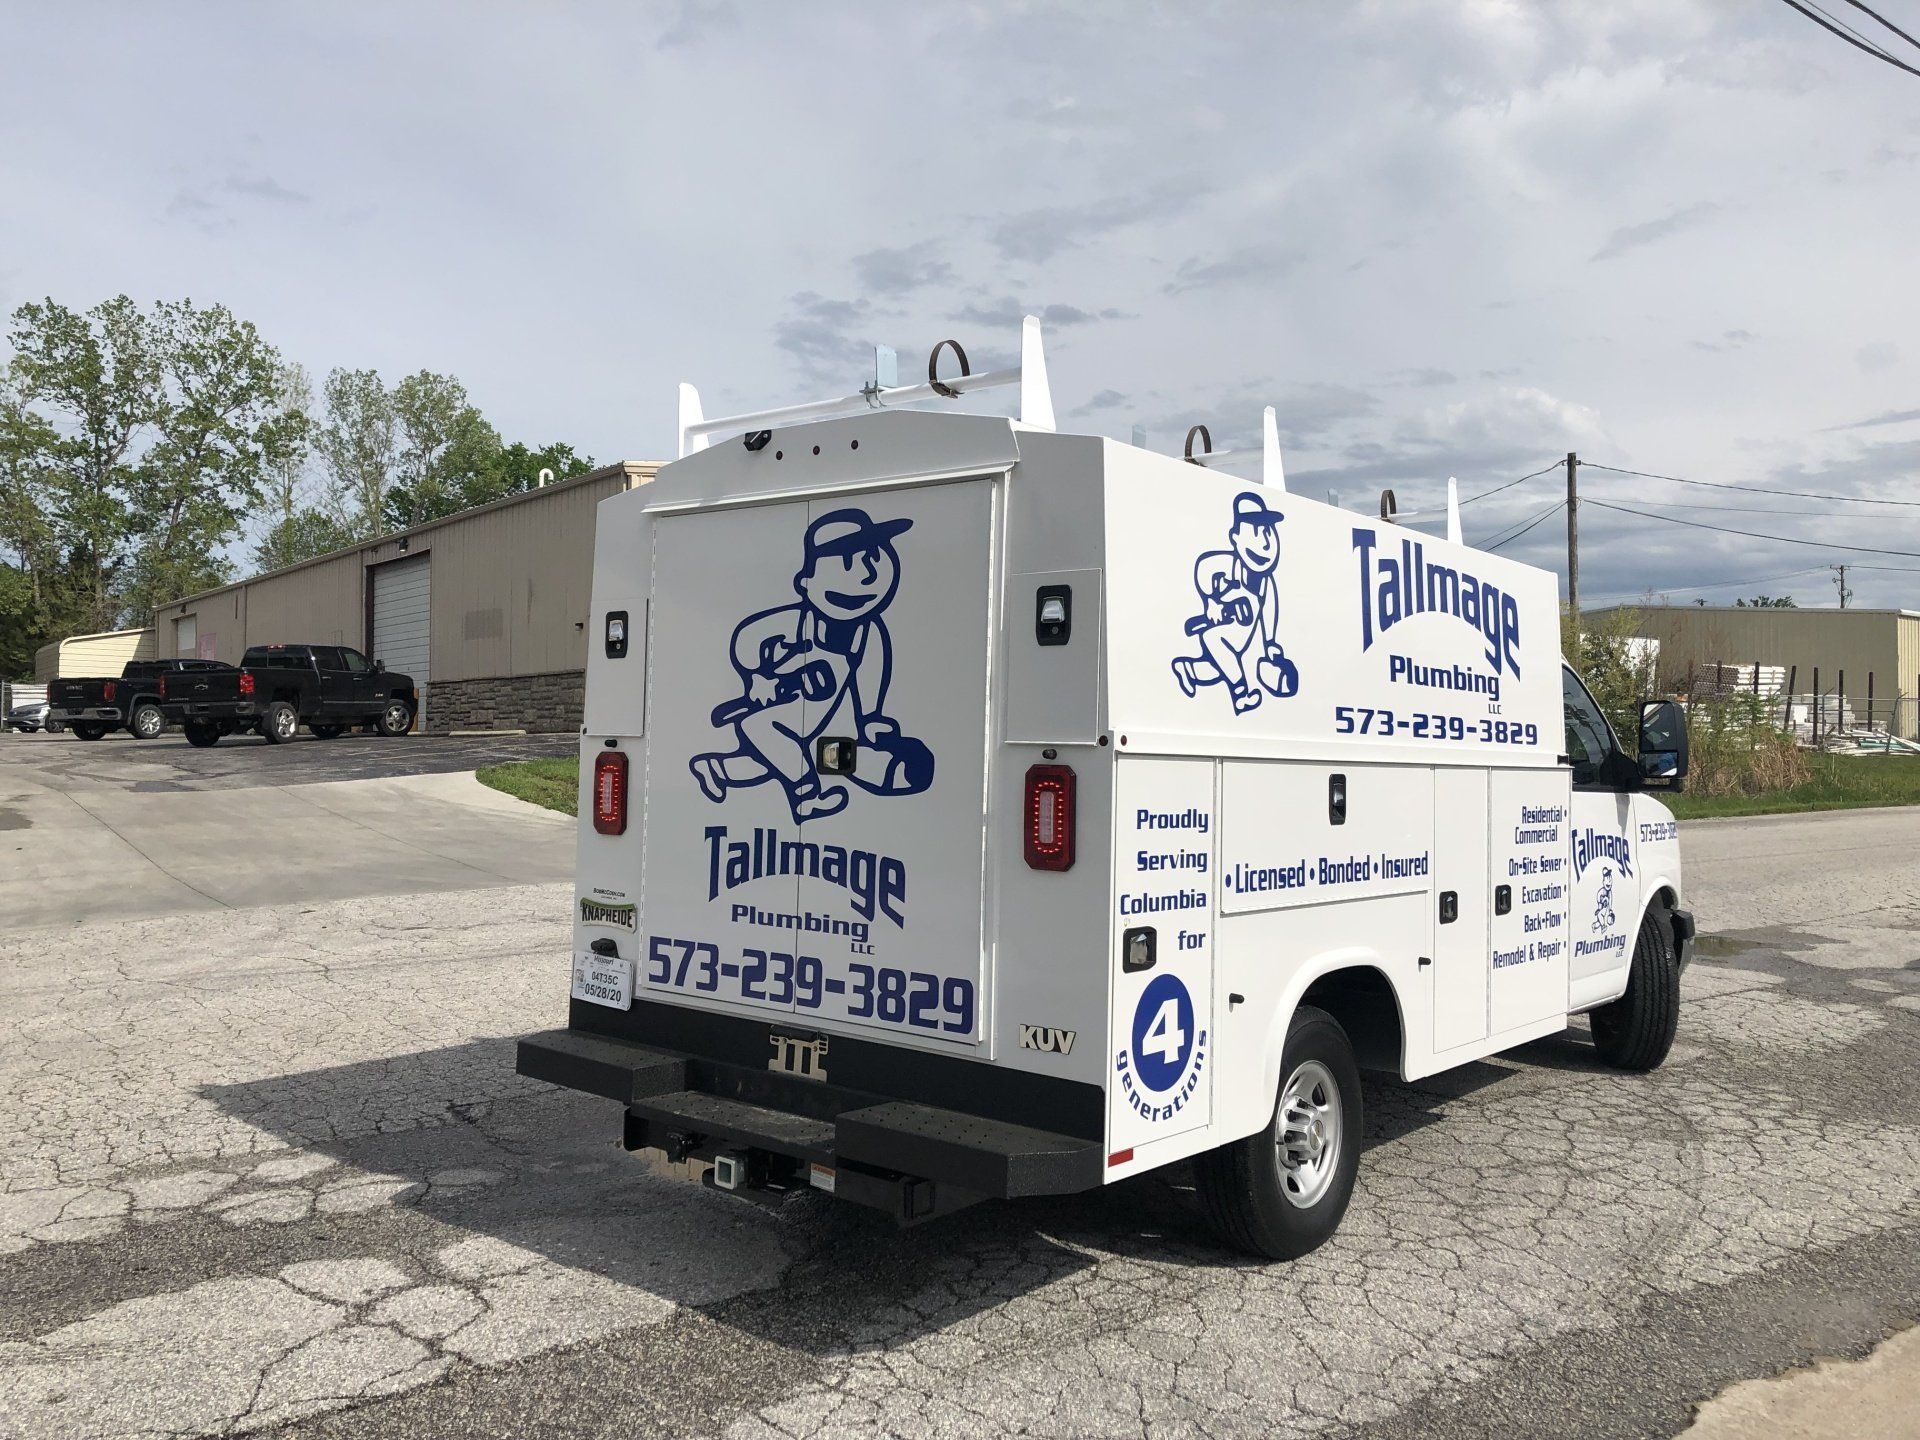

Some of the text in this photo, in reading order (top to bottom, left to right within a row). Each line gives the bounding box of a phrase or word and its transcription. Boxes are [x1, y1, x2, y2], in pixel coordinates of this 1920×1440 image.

[1352, 527, 1520, 682] Tallmage
[1389, 654, 1500, 701] Plumbing
[1488, 703, 1502, 715] LLC
[1335, 706, 1538, 746] 573-239-3829
[1136, 808, 1209, 833] Proudly
[1521, 805, 1563, 824] Residential
[1515, 827, 1558, 844] Commercial
[1136, 849, 1208, 872] Serving
[1508, 854, 1562, 876] On-Site Sewer
[1571, 827, 1634, 885] Tallmage
[704, 825, 906, 930] Tallmage
[1235, 851, 1429, 894] Licensed Bonded Insured
[1120, 890, 1207, 915] Columbia
[1522, 884, 1562, 904] Excavation
[581, 902, 633, 928] KNAPHEIDE
[731, 904, 869, 943] Plumbing
[1524, 911, 1561, 933] Back-Flow
[850, 942, 876, 955] LLC
[1177, 931, 1206, 951] for
[1493, 938, 1561, 969] Remodel & Repair
[1574, 933, 1627, 958] Plumbing
[591, 970, 619, 986] 04T35C
[648, 936, 974, 1035] 573-239-3829
[584, 982, 622, 1003] 05/28/20
[1019, 1024, 1076, 1055] KUV
[1142, 998, 1185, 1065] 4
[1116, 1029, 1207, 1123] generations
